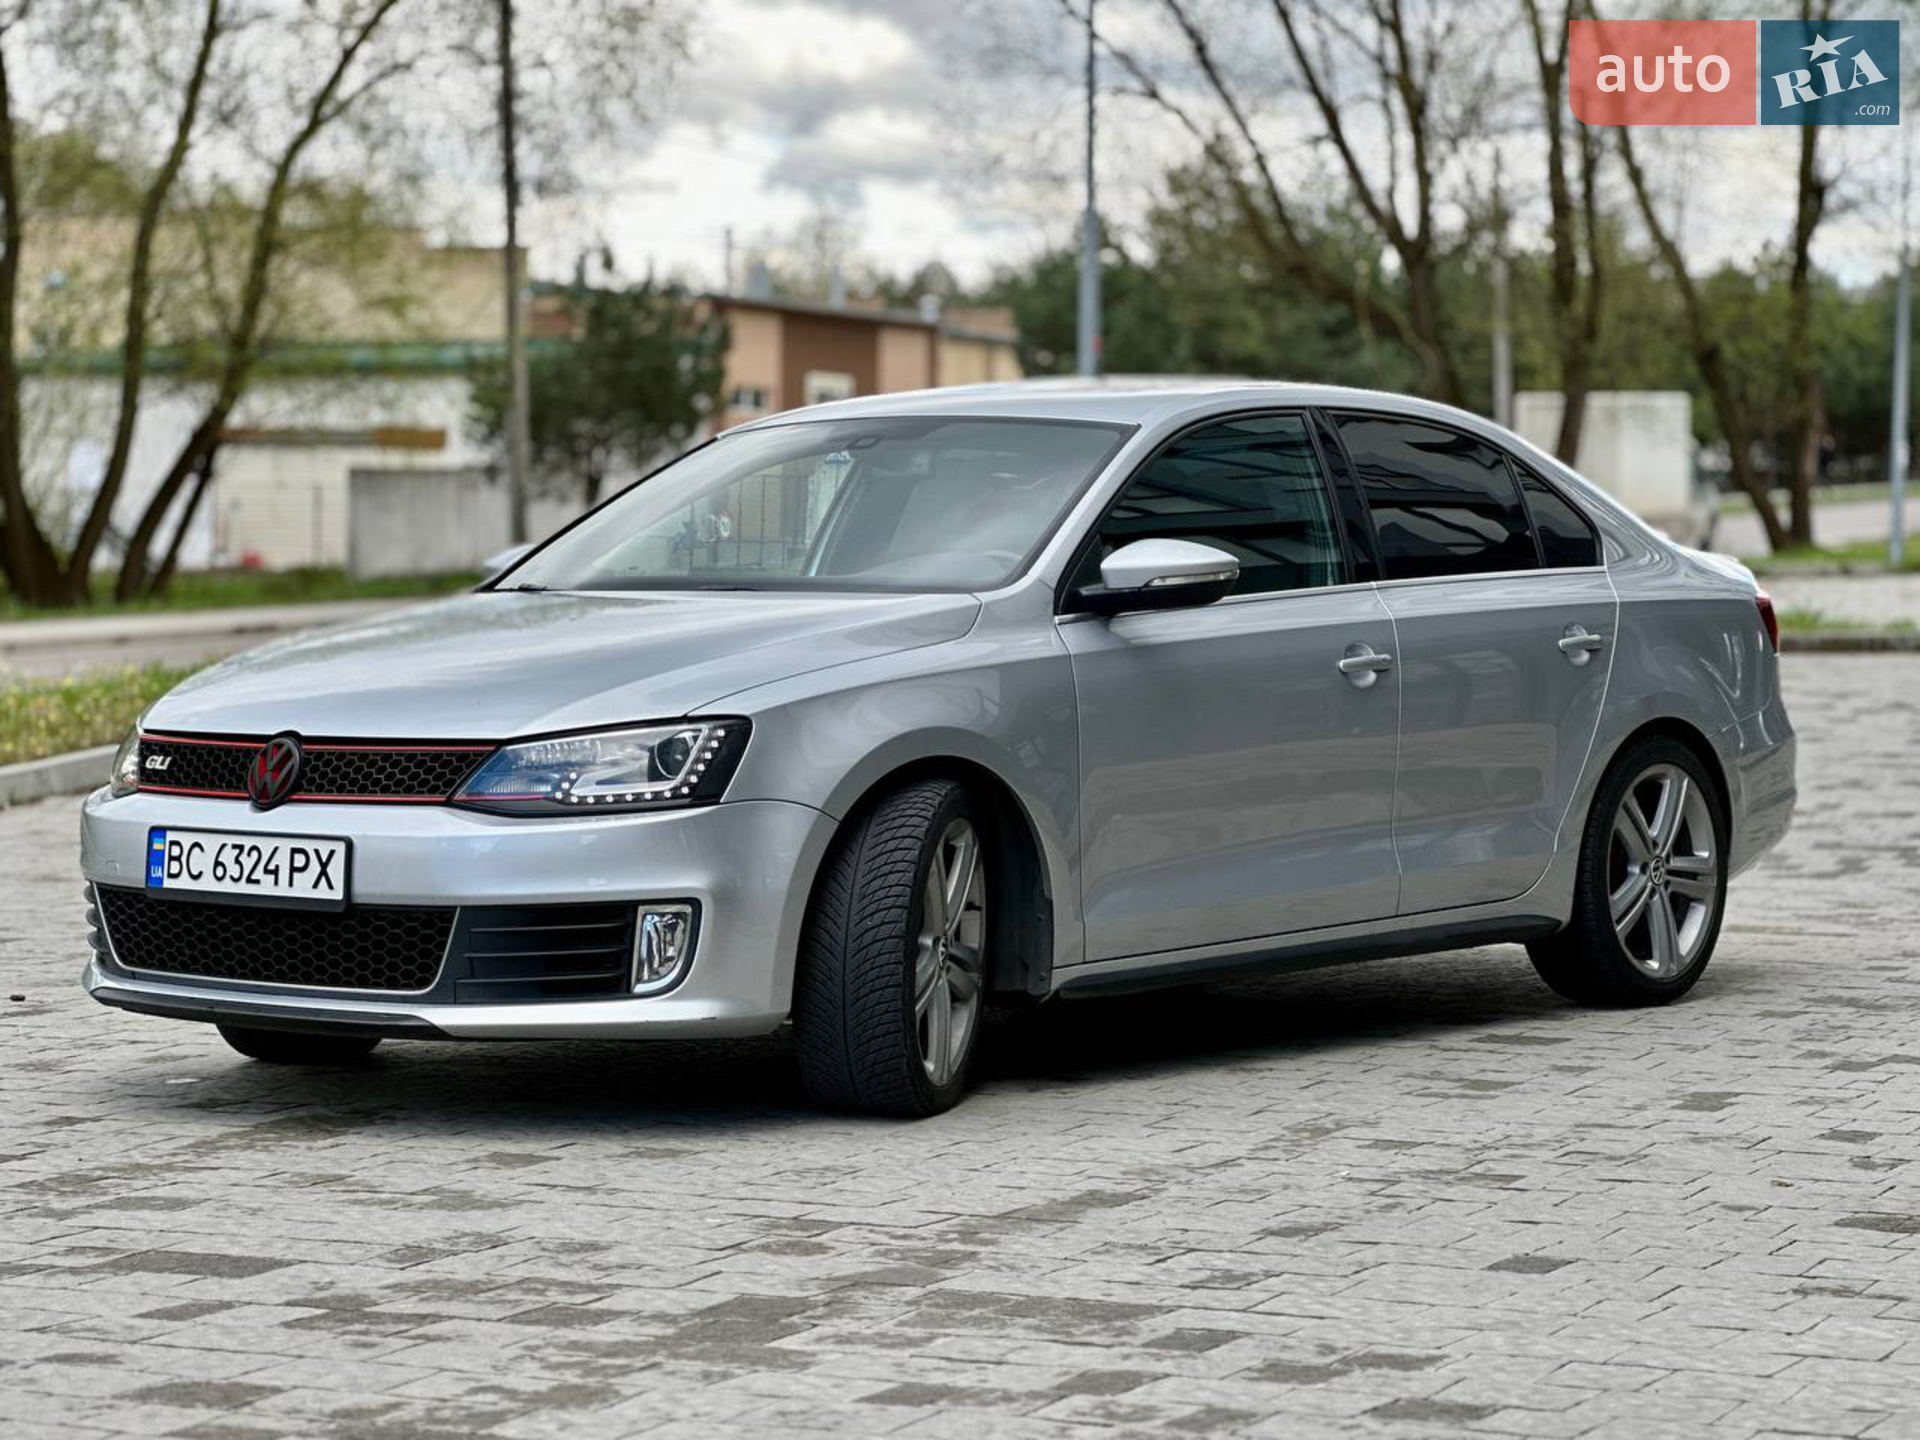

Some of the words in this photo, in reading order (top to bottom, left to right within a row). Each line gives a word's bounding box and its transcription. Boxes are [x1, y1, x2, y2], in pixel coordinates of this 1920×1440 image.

[145, 755, 172, 770] GLI
[151, 865, 163, 878] UA
[167, 839, 205, 881] BC
[212, 842, 280, 887] 6324
[288, 846, 337, 891] PX
